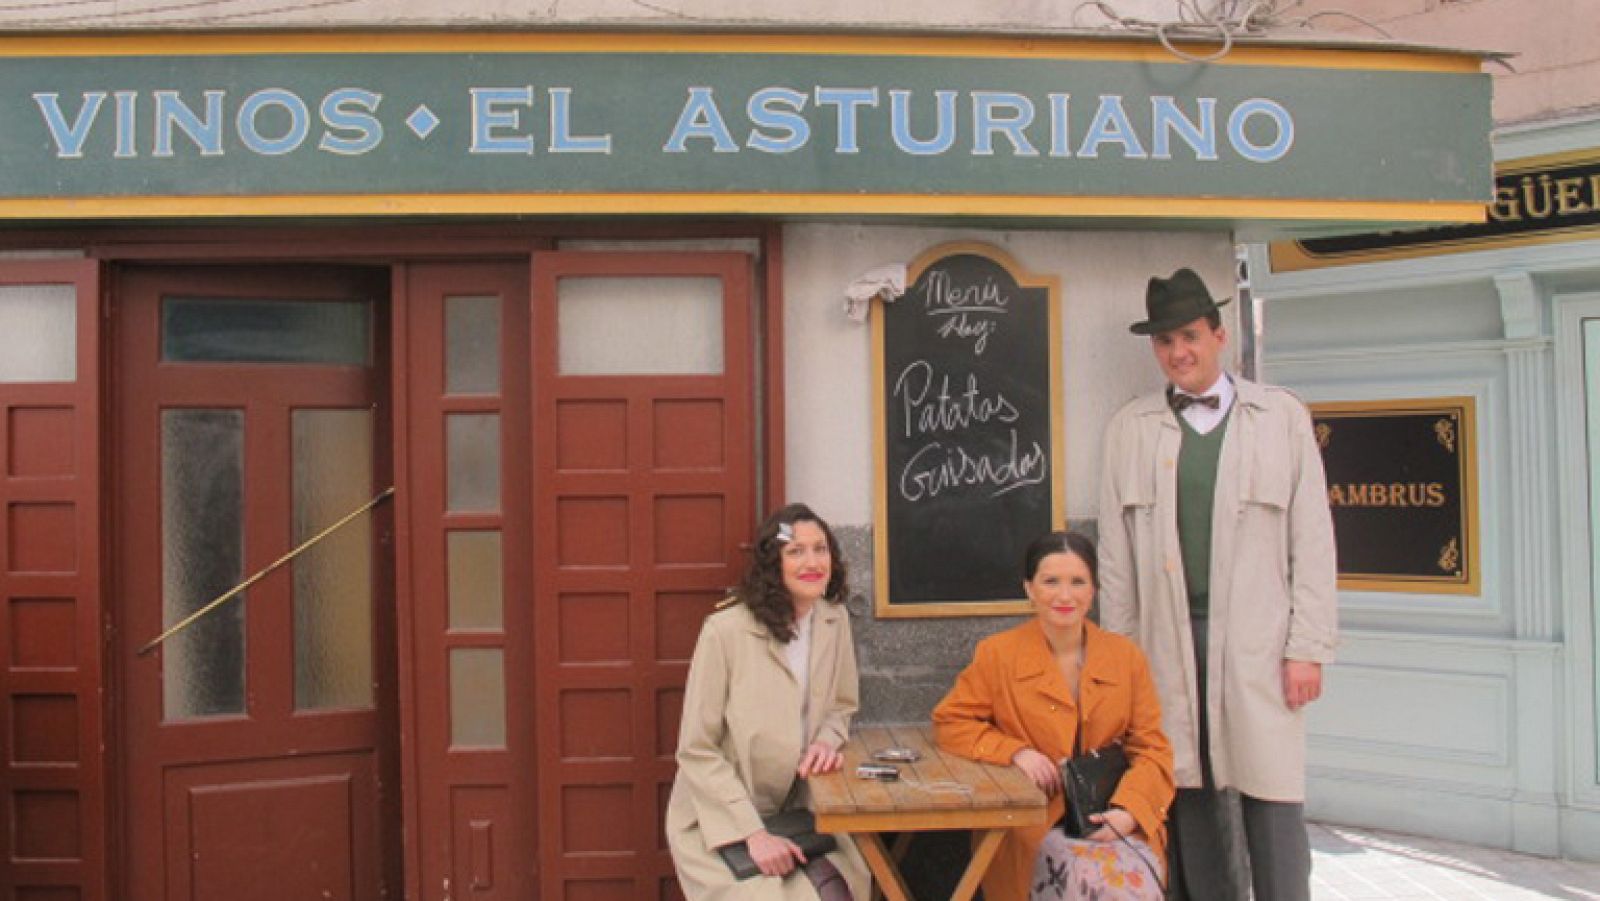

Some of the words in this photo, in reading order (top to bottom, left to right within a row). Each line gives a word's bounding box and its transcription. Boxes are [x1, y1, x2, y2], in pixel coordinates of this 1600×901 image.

[33, 87, 384, 158] VINOS
[468, 85, 612, 156] EL
[662, 85, 1296, 163] ASTURIANO
[893, 360, 1020, 438] Patatas
[1328, 482, 1446, 507] AMBRUS
